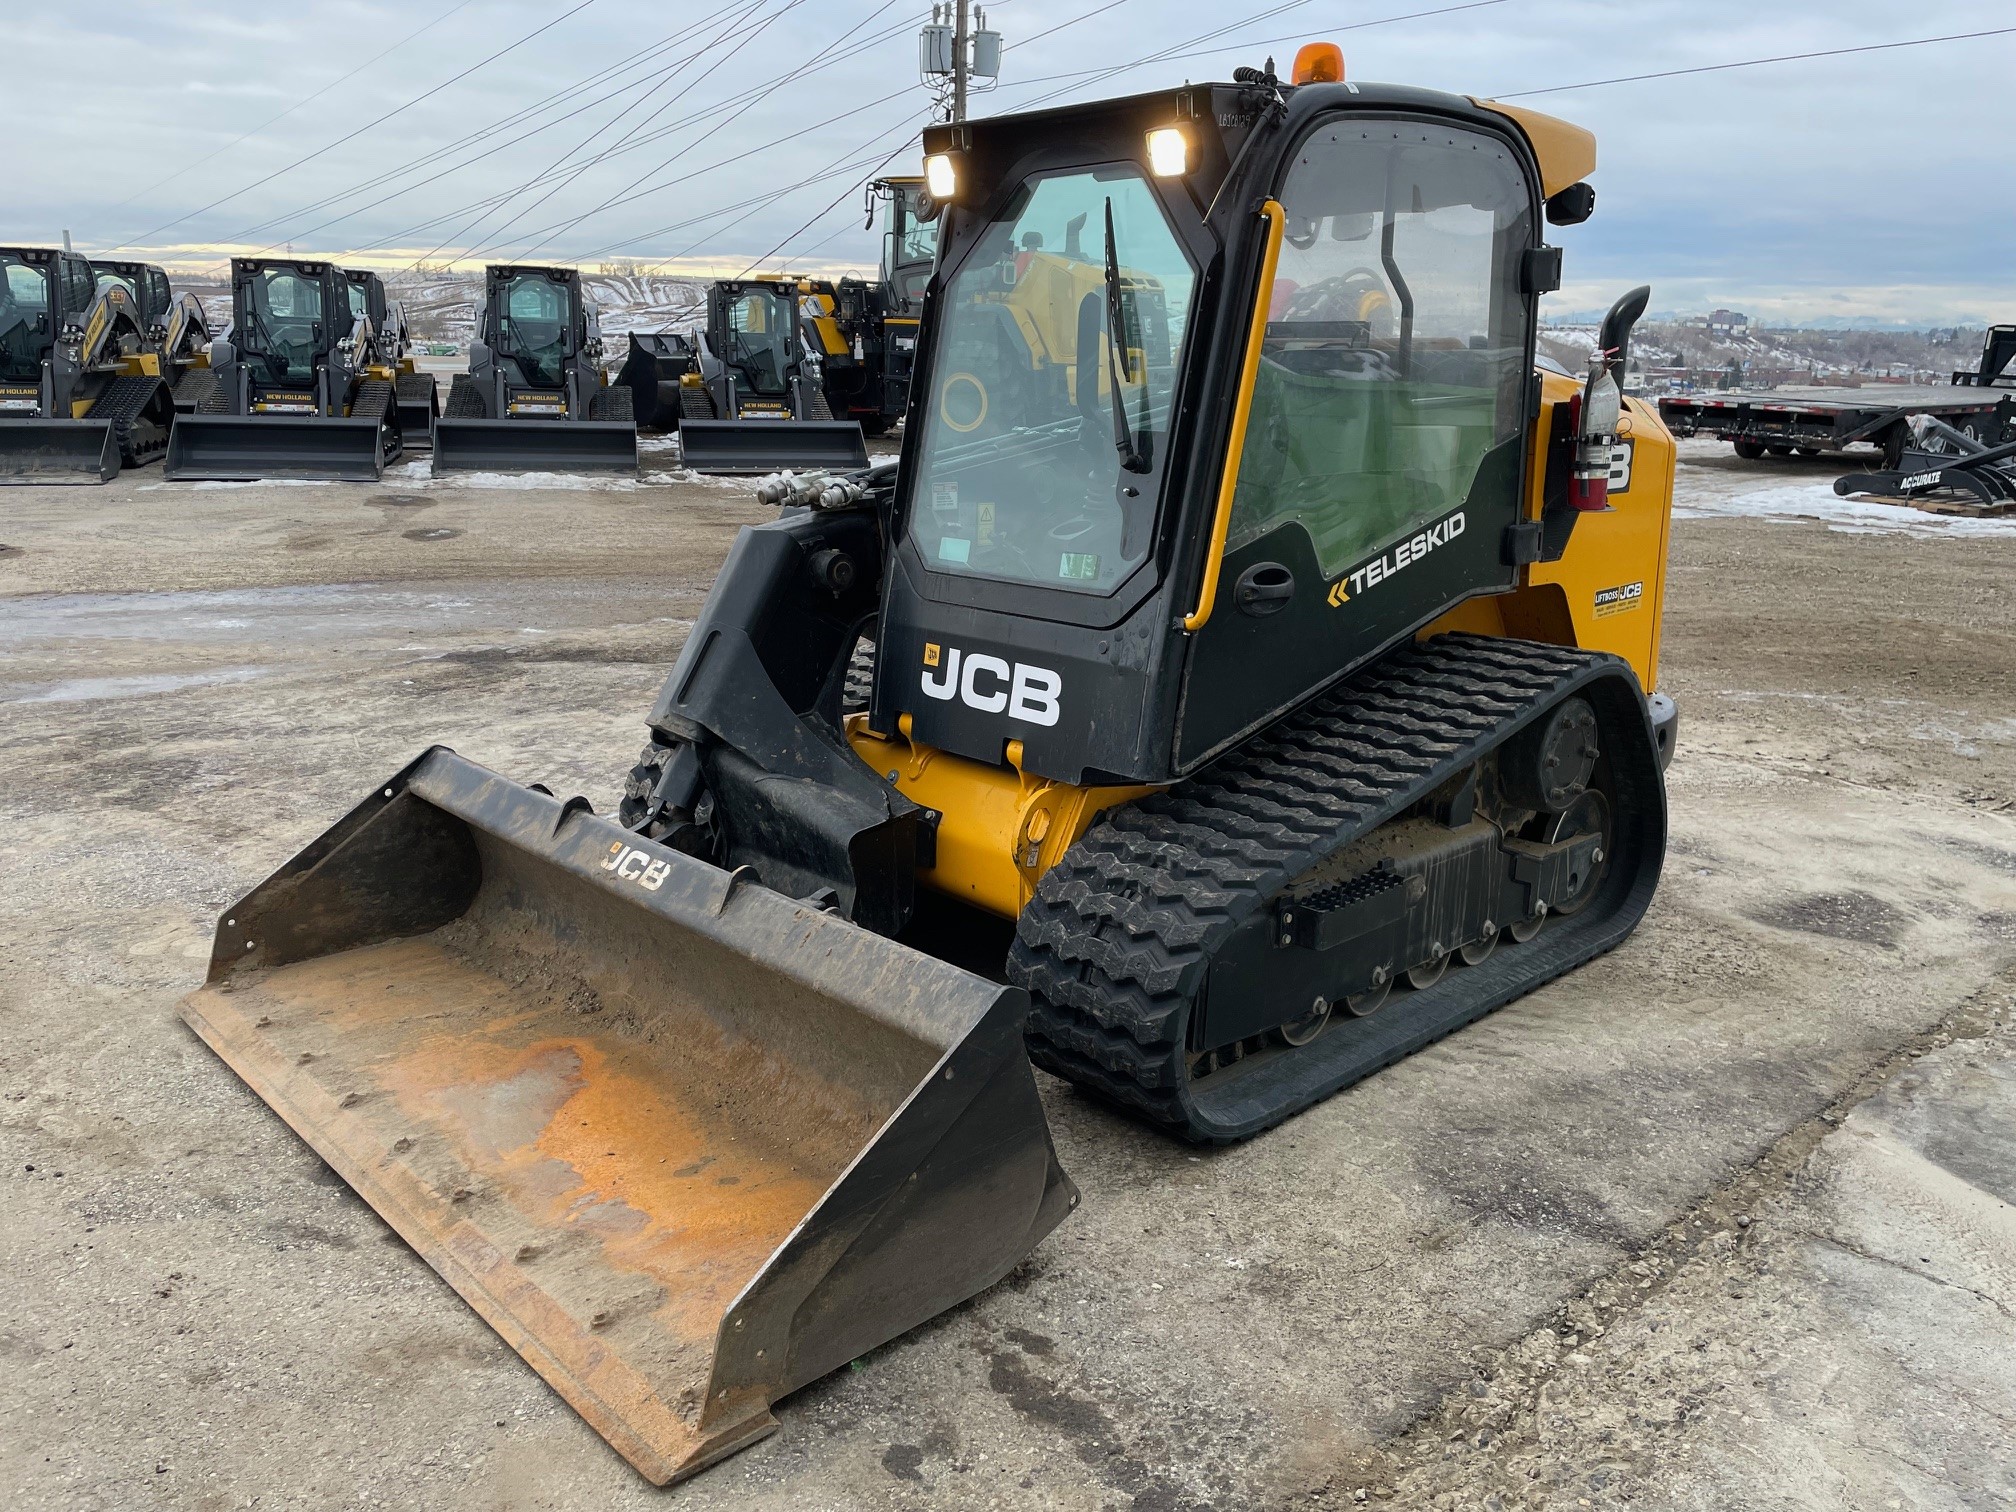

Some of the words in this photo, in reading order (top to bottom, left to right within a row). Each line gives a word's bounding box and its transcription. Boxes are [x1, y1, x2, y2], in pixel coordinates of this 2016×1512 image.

[1900, 471, 1942, 490] ACCURATE
[1350, 511, 1466, 595] TELESKID
[1595, 590, 1618, 604] LIFTBOSS
[1619, 582, 1642, 600] JCB
[921, 647, 1062, 727] JCB
[600, 845, 671, 891] JCB
